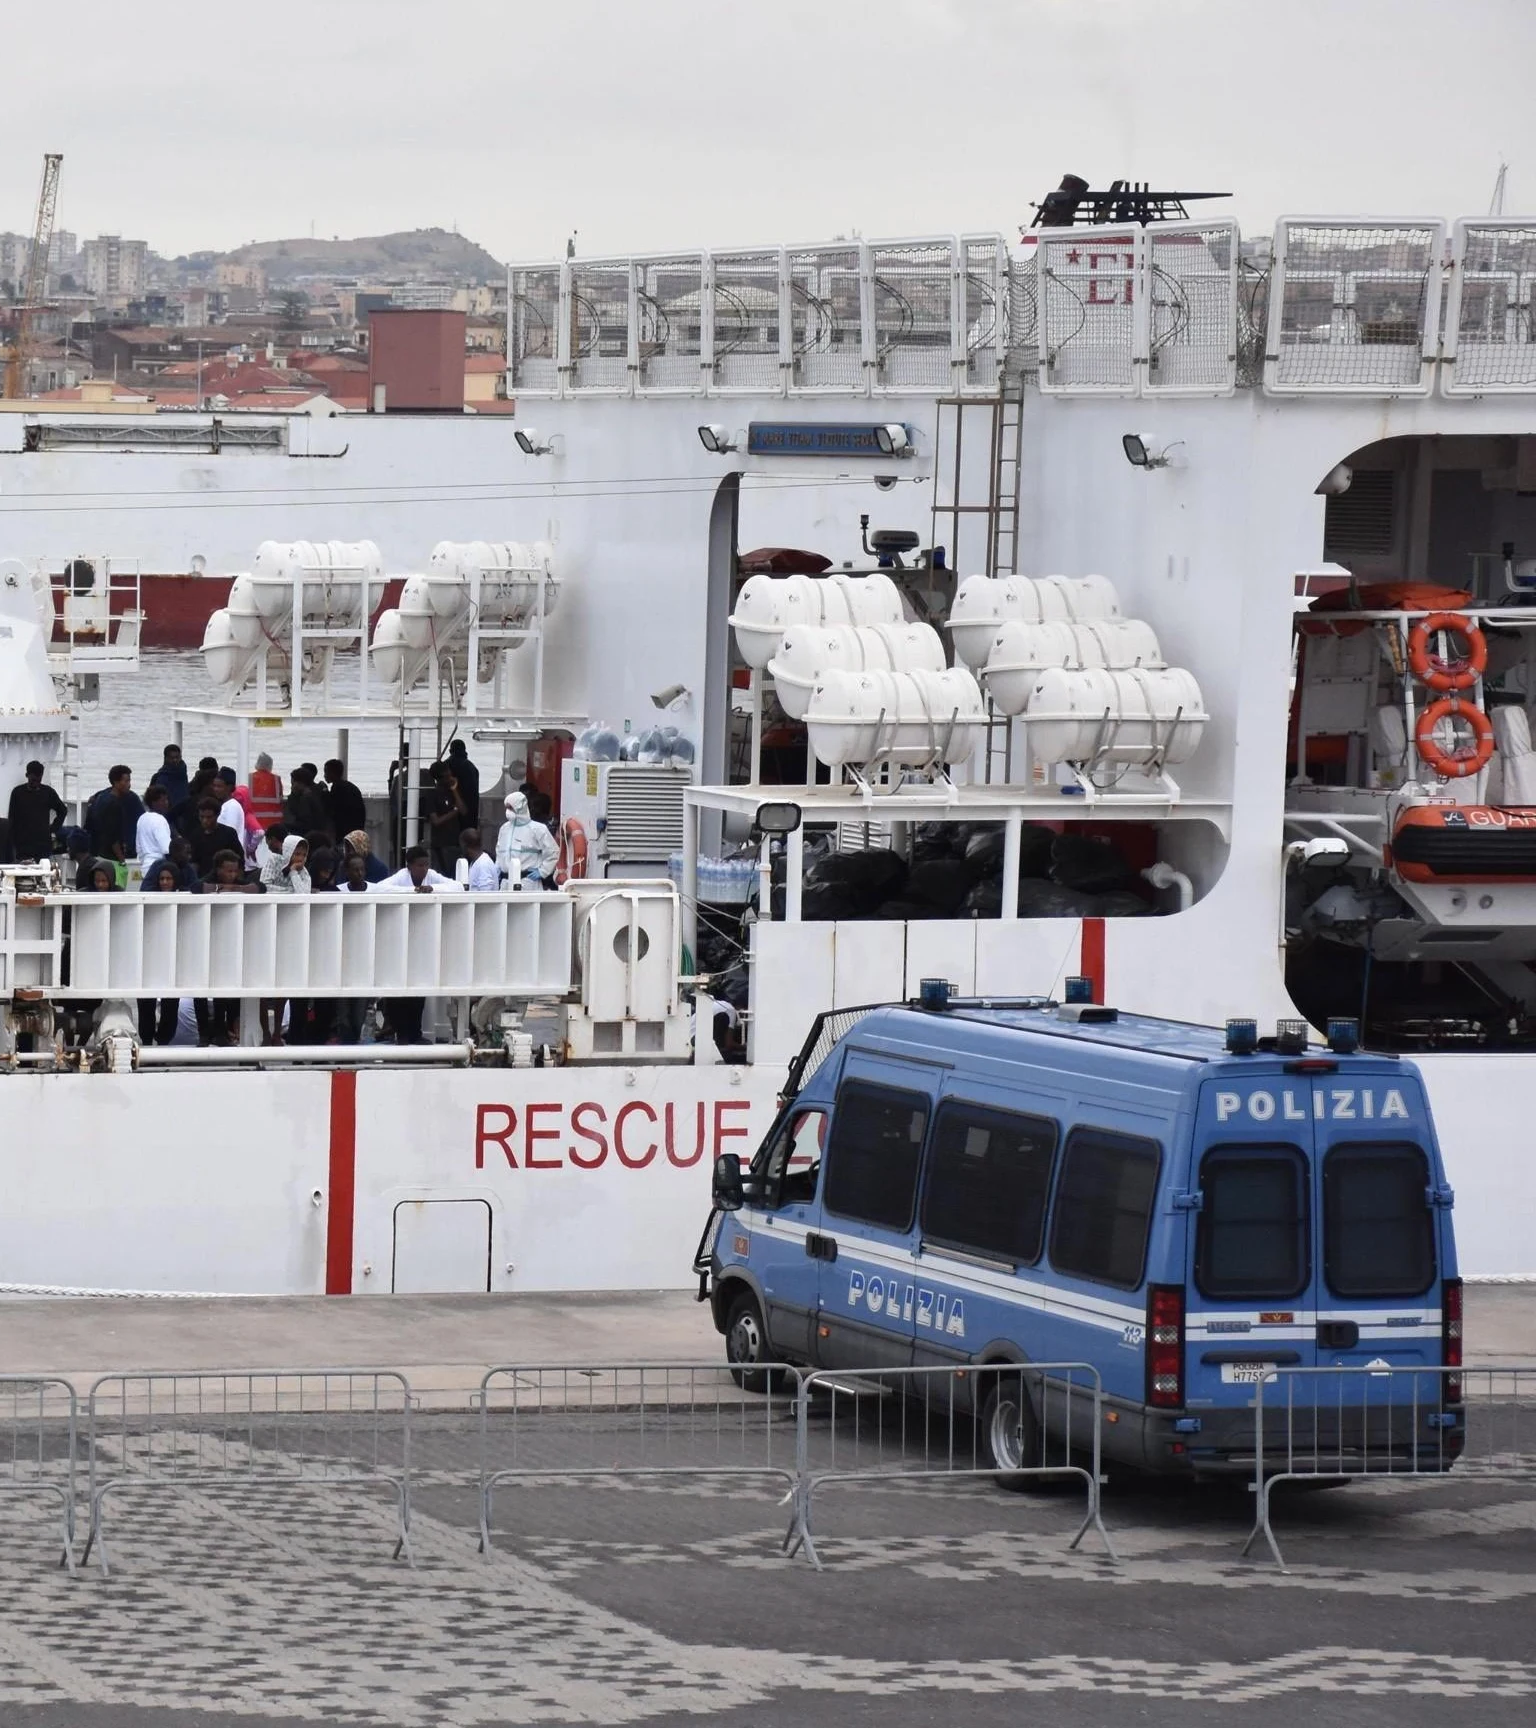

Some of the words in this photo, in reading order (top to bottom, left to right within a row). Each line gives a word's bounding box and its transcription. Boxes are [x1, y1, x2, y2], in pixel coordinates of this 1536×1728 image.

[1216, 1090, 1410, 1121] POLIZIA
[475, 1101, 751, 1169] RESCUE
[848, 1270, 965, 1336] POLIZIA
[1233, 1363, 1264, 1371] POLIZIA
